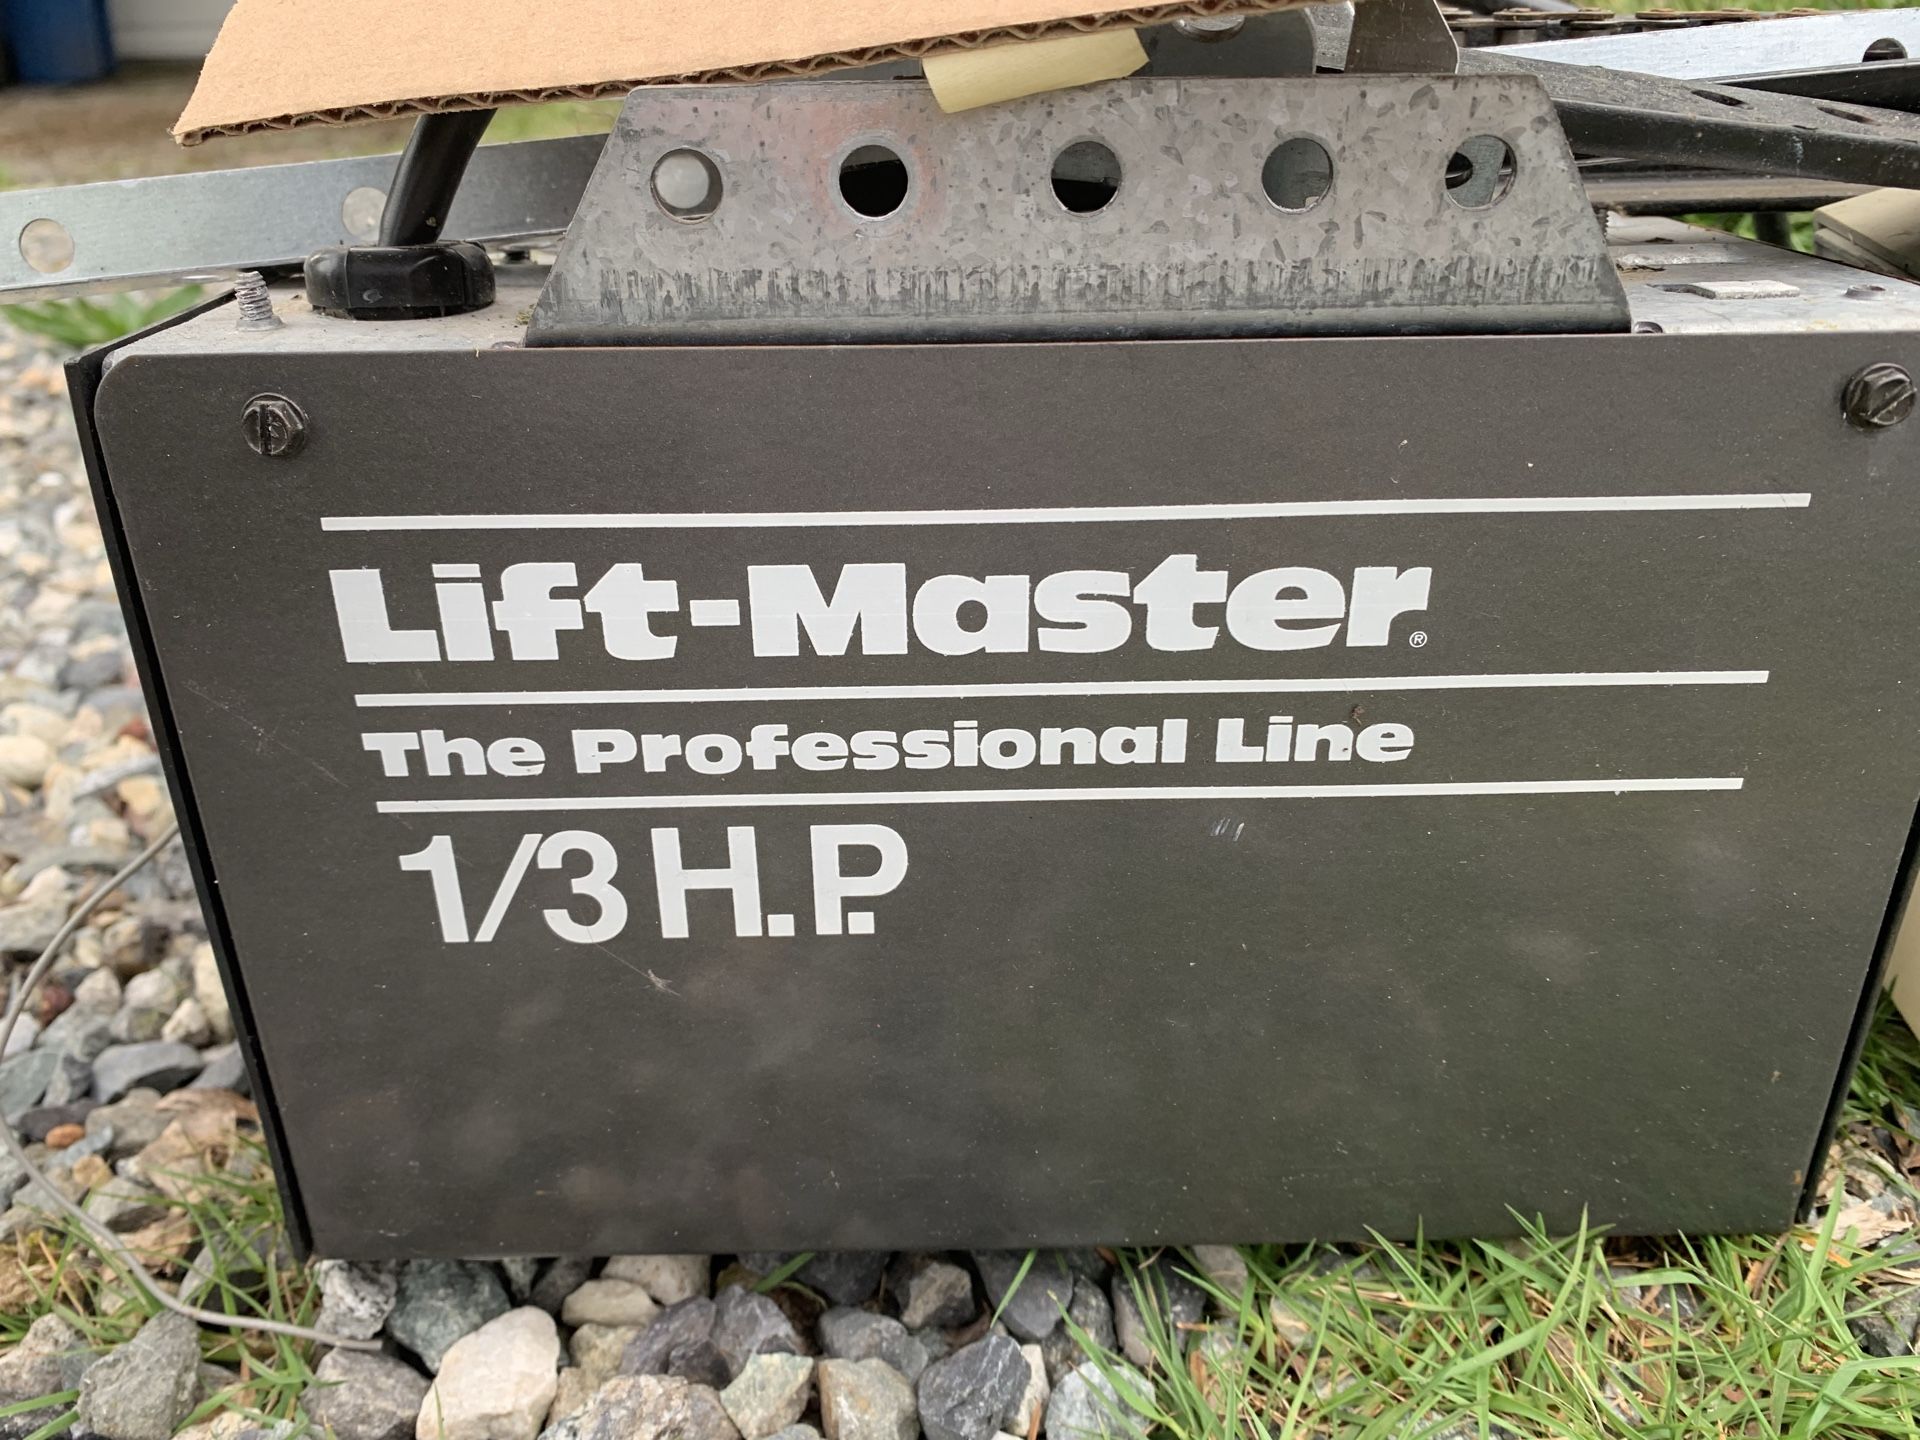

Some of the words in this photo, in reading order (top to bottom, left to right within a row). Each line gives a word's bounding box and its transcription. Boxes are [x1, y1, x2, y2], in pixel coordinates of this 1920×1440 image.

[361, 729, 546, 777] The
[571, 718, 1190, 775] Professional
[1215, 715, 1415, 764] Line
[398, 829, 629, 944] 1/3
